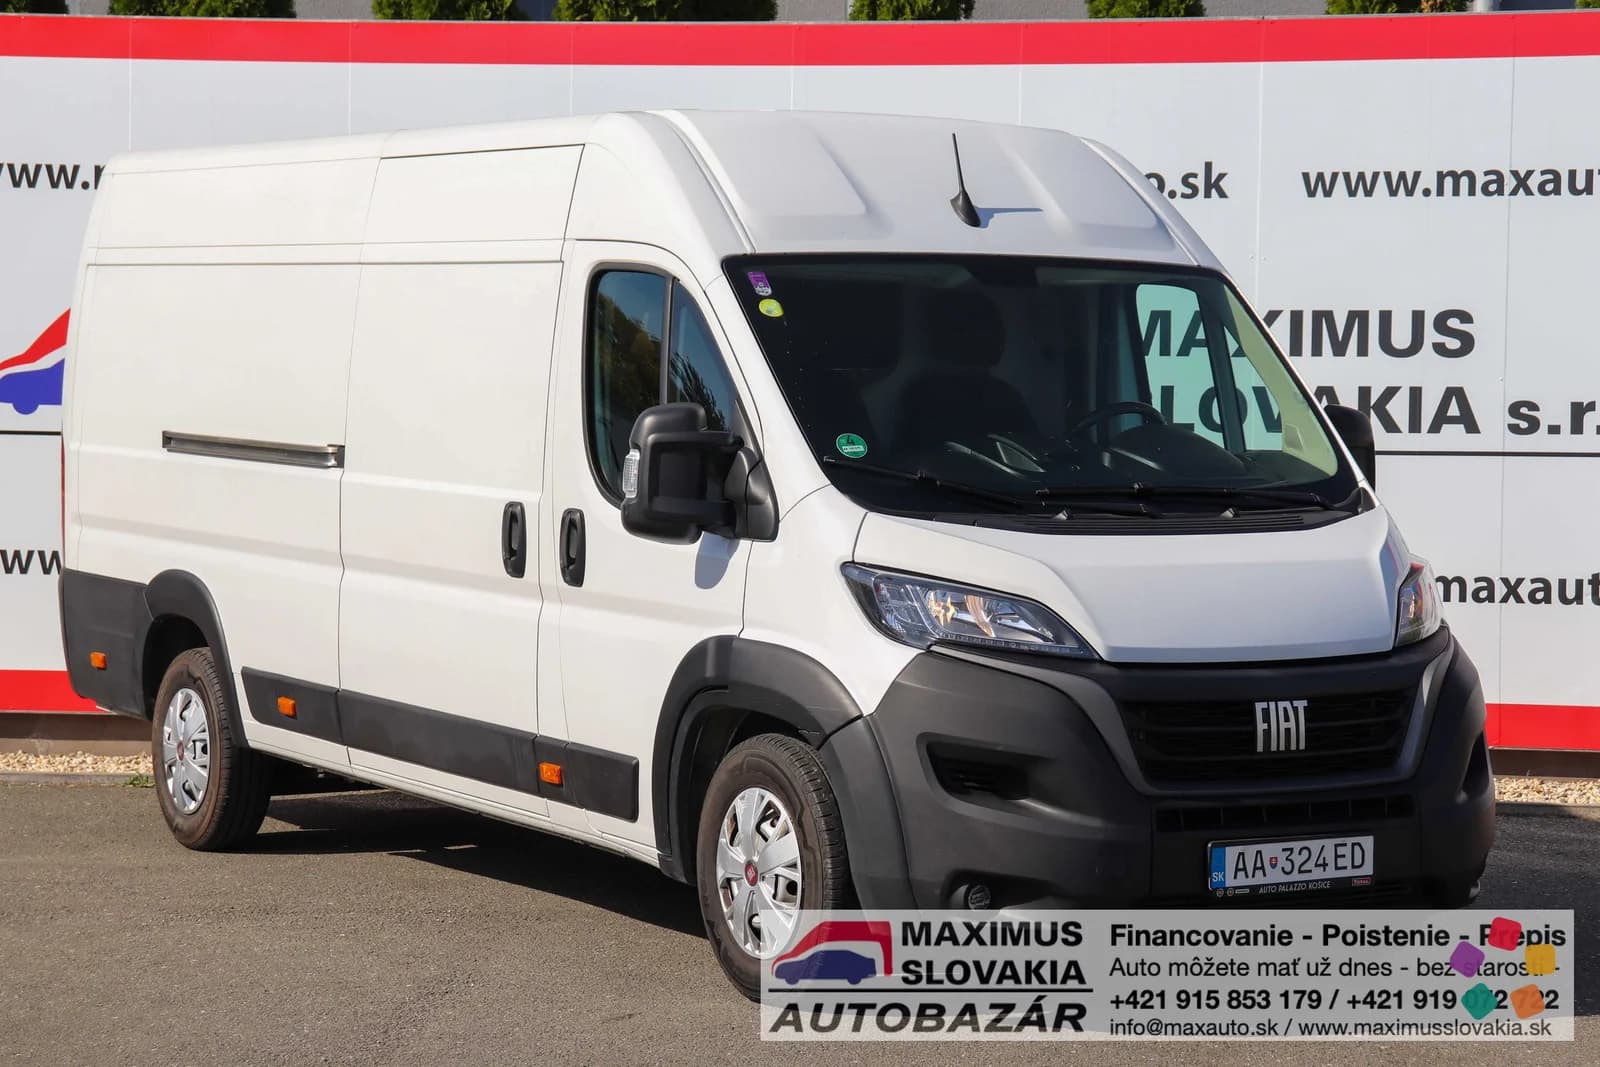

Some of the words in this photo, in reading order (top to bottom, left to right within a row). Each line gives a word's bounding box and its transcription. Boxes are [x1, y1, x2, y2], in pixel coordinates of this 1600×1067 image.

[0, 162, 105, 190] ww.
[1302, 167, 1600, 198] www.maxau
[1255, 700, 1308, 752] FIAT
[1212, 871, 1224, 882] SK
[1259, 885, 1277, 894] AUTO
